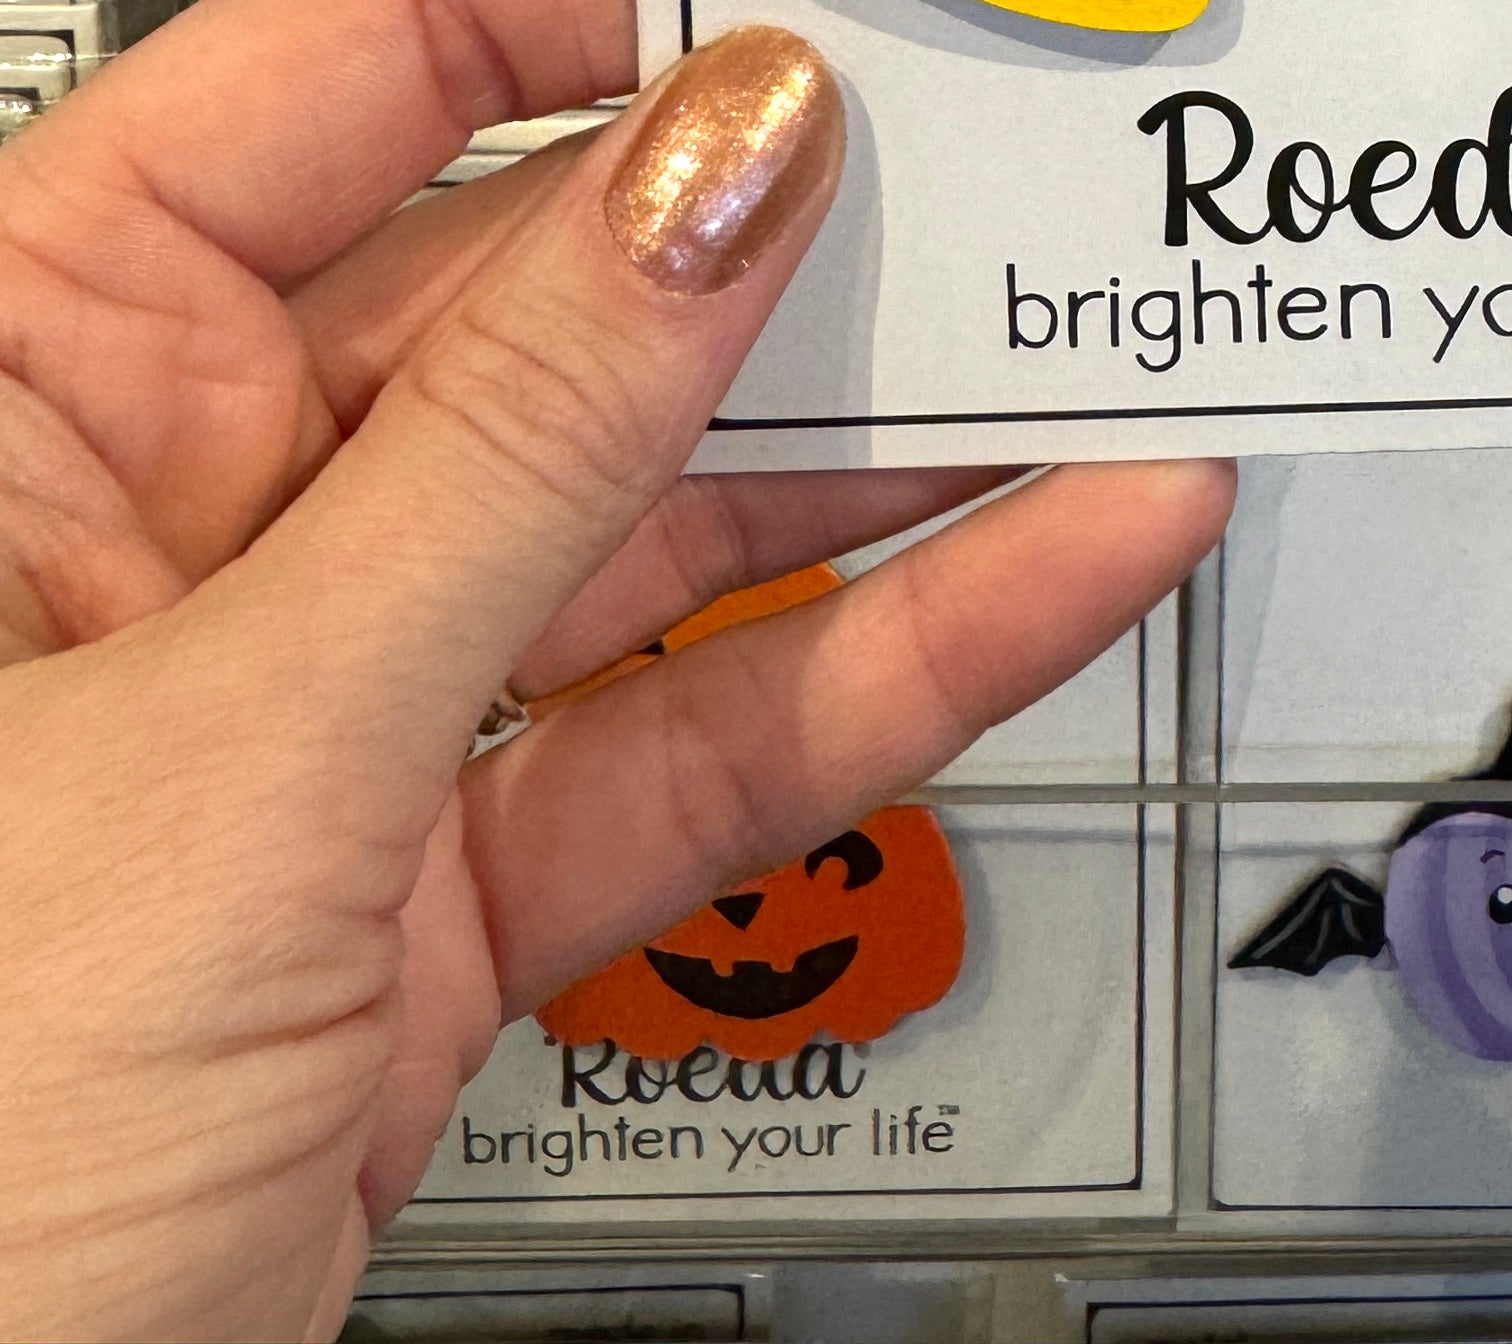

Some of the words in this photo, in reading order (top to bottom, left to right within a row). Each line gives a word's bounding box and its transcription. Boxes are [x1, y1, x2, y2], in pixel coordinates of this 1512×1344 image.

[1006, 258, 1392, 374] brighten
[461, 1113, 704, 1177] brighten
[721, 1123, 852, 1173] your
